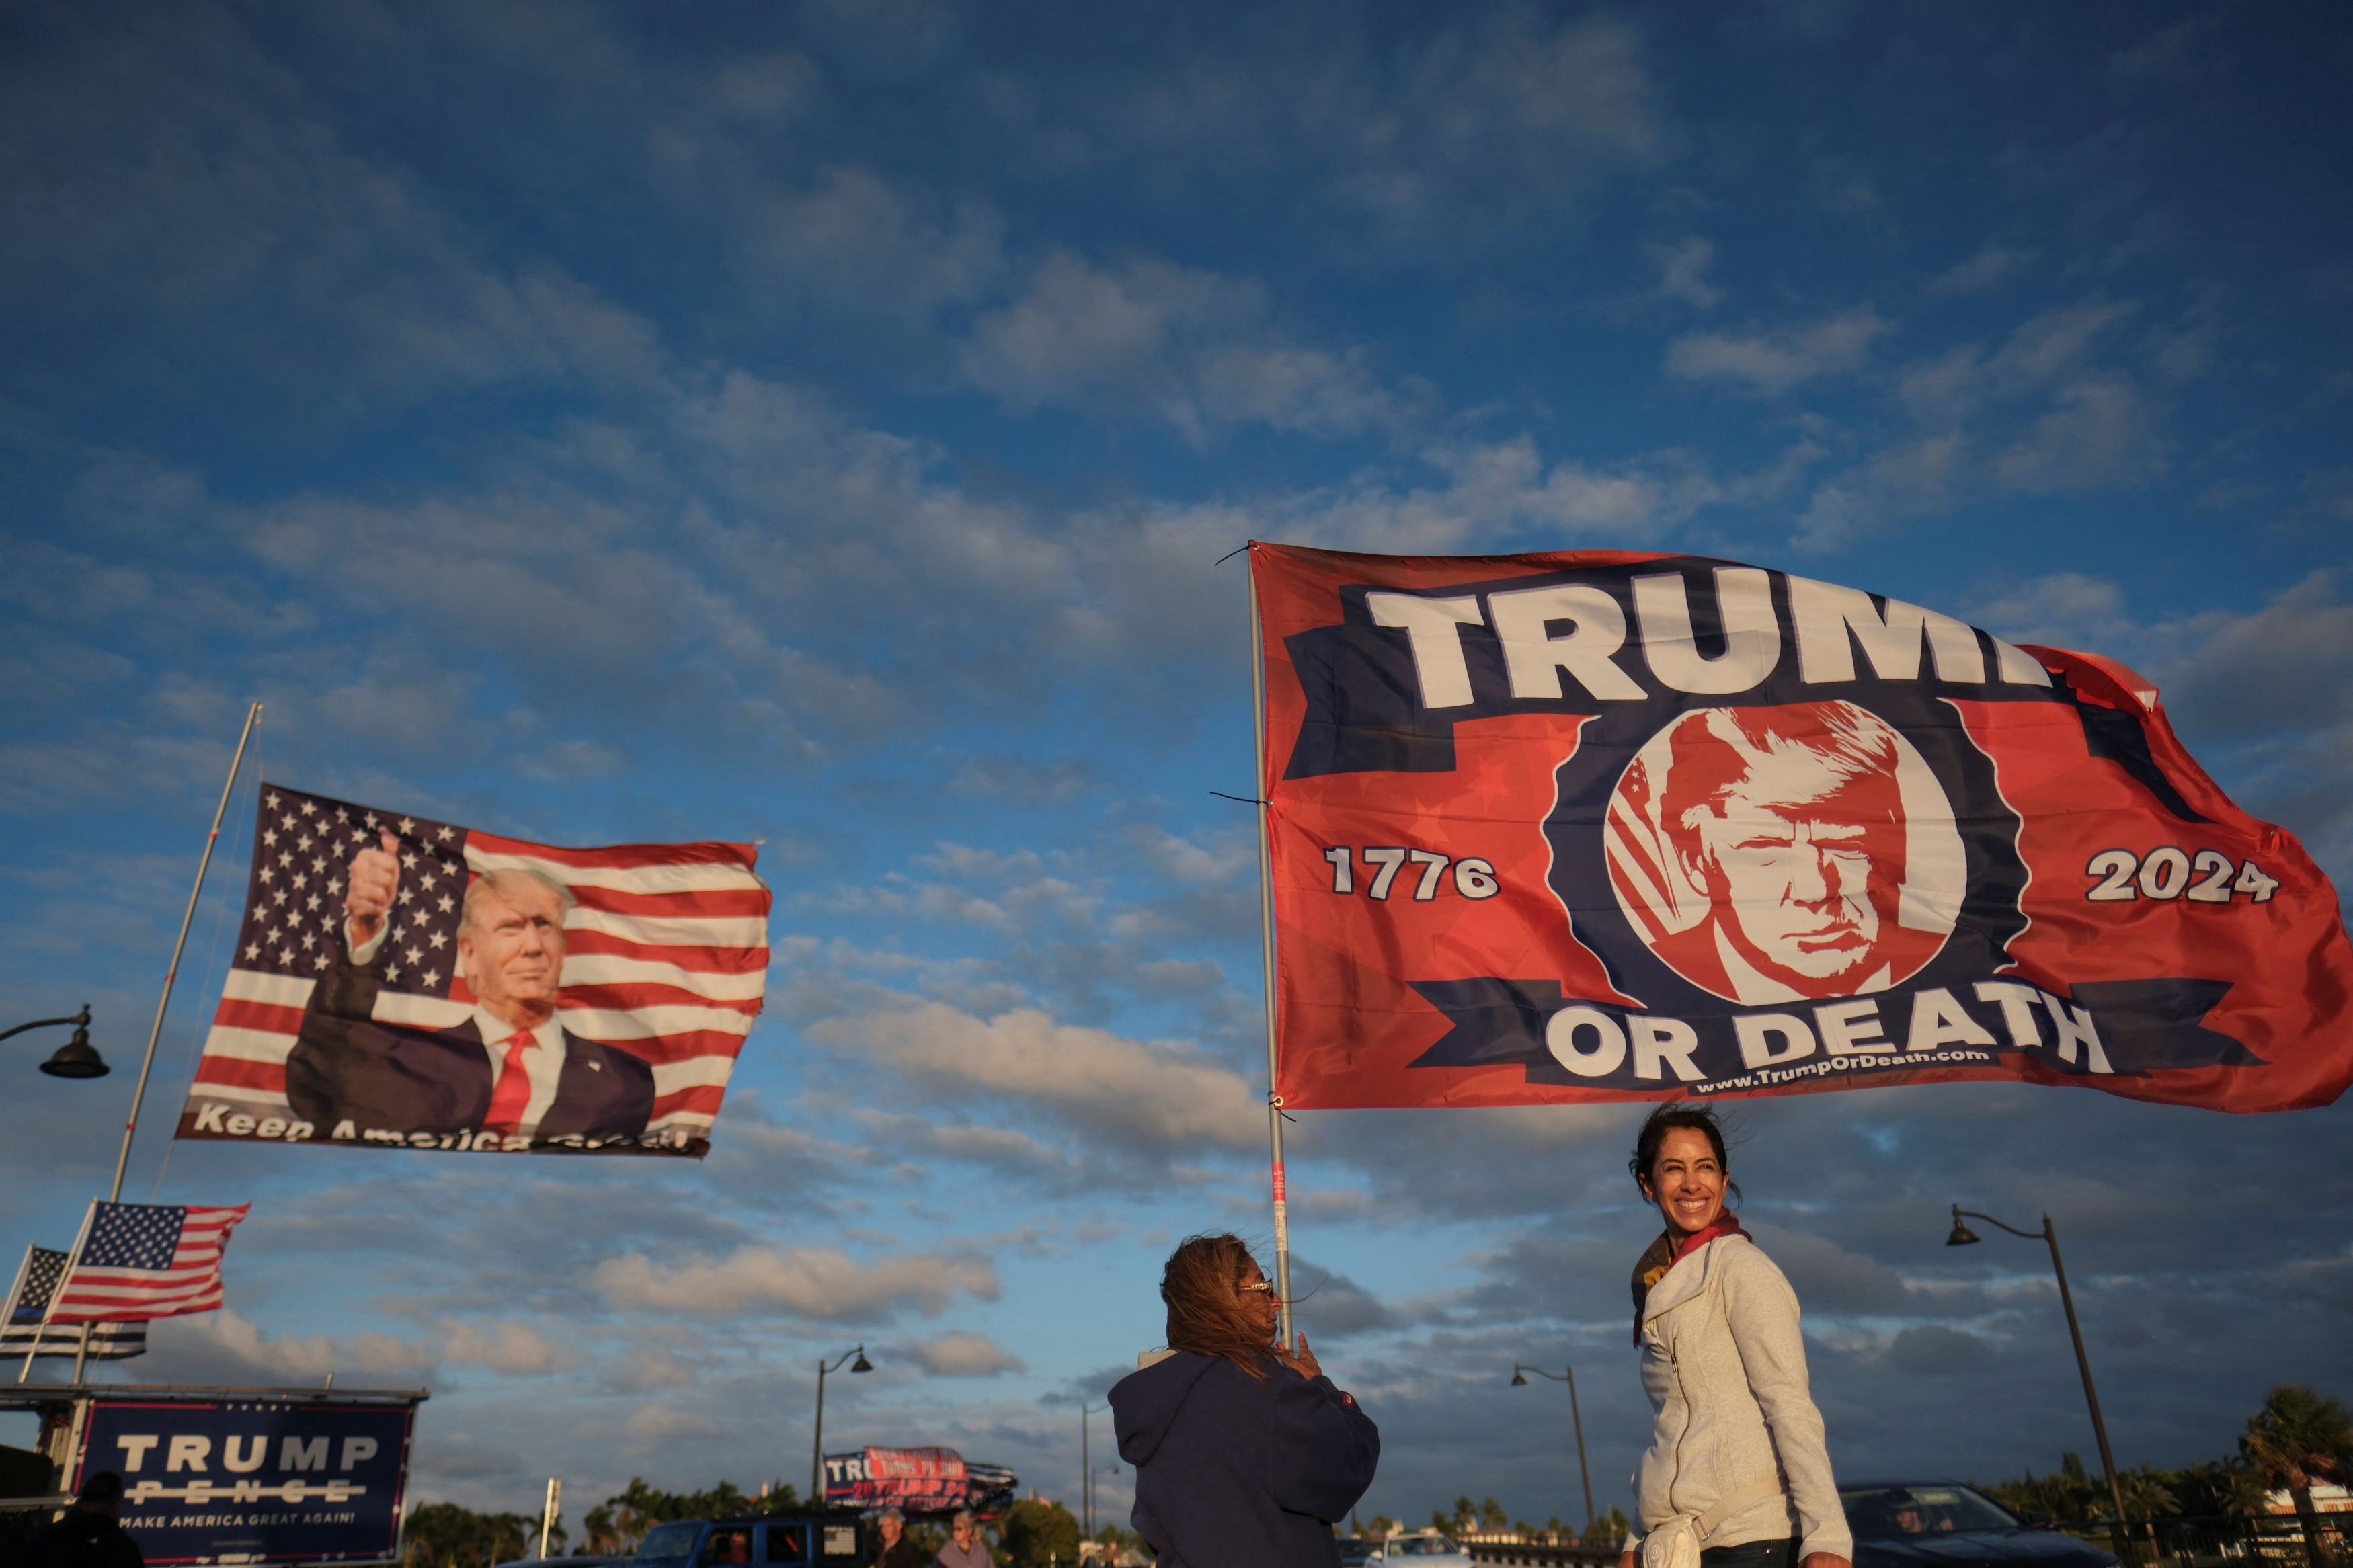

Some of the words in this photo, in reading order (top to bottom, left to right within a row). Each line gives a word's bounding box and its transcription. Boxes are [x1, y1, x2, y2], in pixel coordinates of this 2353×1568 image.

[1323, 845, 1501, 901] 1776
[2085, 845, 2281, 905] 2024
[1546, 1005, 1707, 1082] OR
[1732, 981, 2114, 1074] DEATH
[1696, 1049, 1990, 1094] www.TrumpOrDeath.com
[193, 1102, 315, 1143] Keep
[116, 1434, 378, 1472] TRUMP
[134, 1480, 350, 1505] PENCE
[118, 1516, 167, 1529] MAKE
[170, 1514, 244, 1528] AMERICA
[248, 1513, 298, 1526] GREAT
[303, 1512, 356, 1525] AGAIN!
